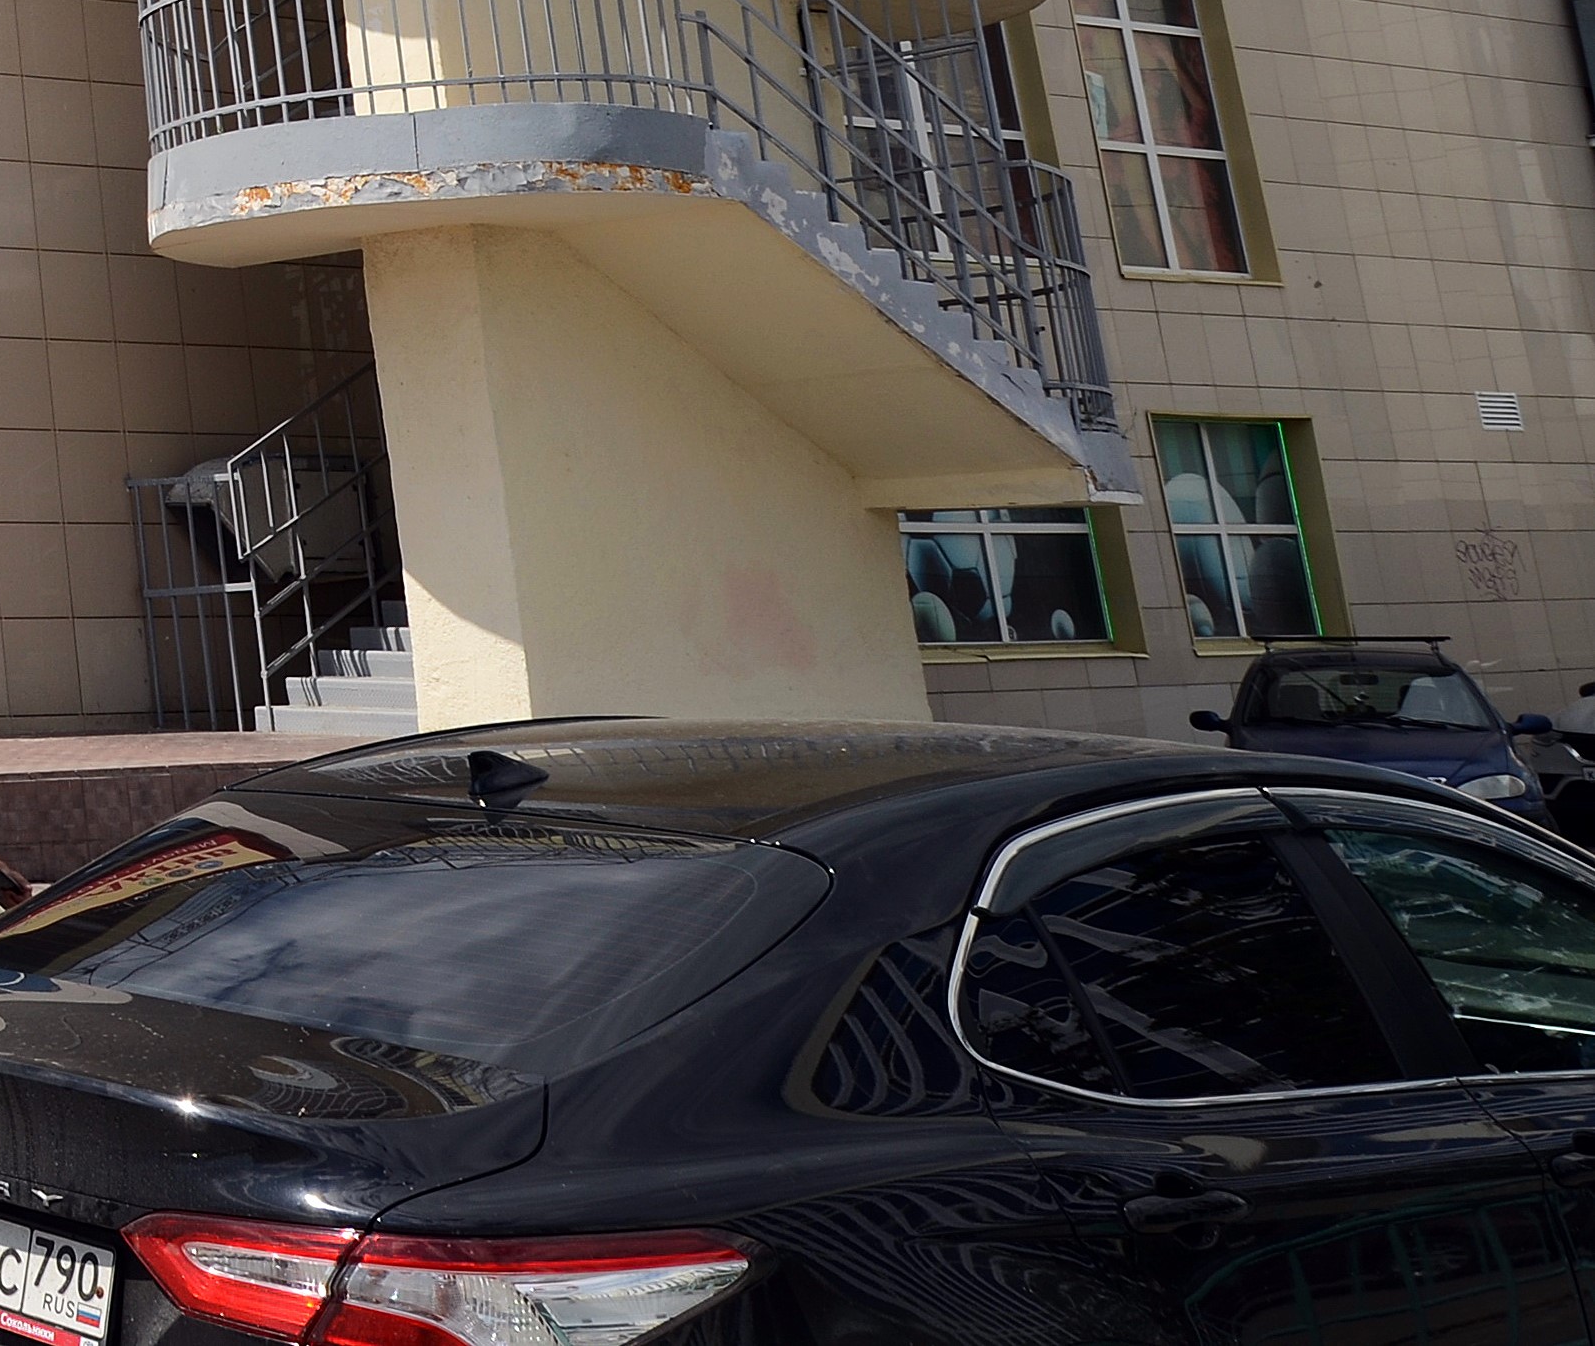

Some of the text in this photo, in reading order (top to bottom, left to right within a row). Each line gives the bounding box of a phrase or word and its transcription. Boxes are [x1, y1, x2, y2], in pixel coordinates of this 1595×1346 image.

[34, 1235, 99, 1302] 790
[42, 1292, 75, 1316] RUS
[0, 1312, 56, 1342] Сокольники
